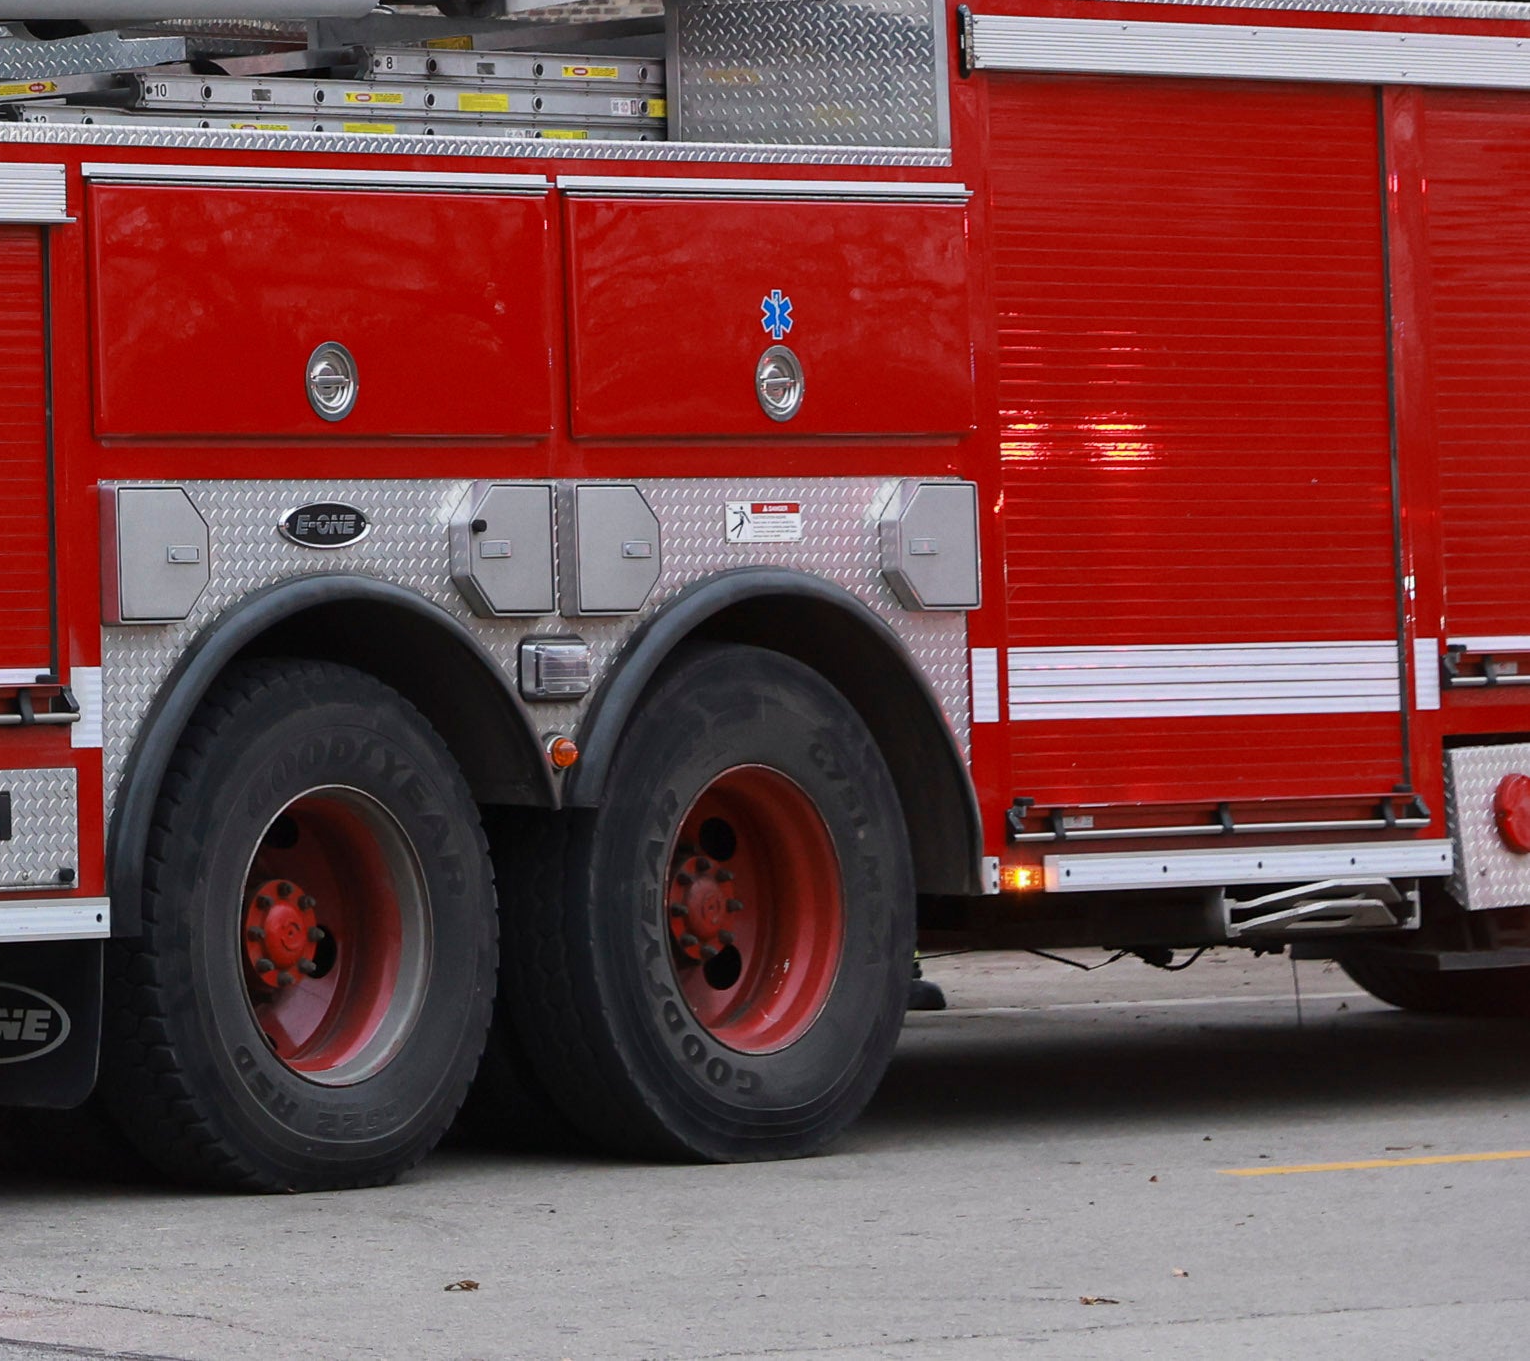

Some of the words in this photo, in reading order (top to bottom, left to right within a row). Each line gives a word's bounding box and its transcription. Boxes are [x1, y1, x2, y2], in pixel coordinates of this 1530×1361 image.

[386, 56, 393, 70] 8
[155, 84, 167, 97] 10
[295, 514, 357, 535] E-ONE
[246, 734, 466, 897] GOODYEAR
[640, 788, 761, 1096] GOODYEAR
